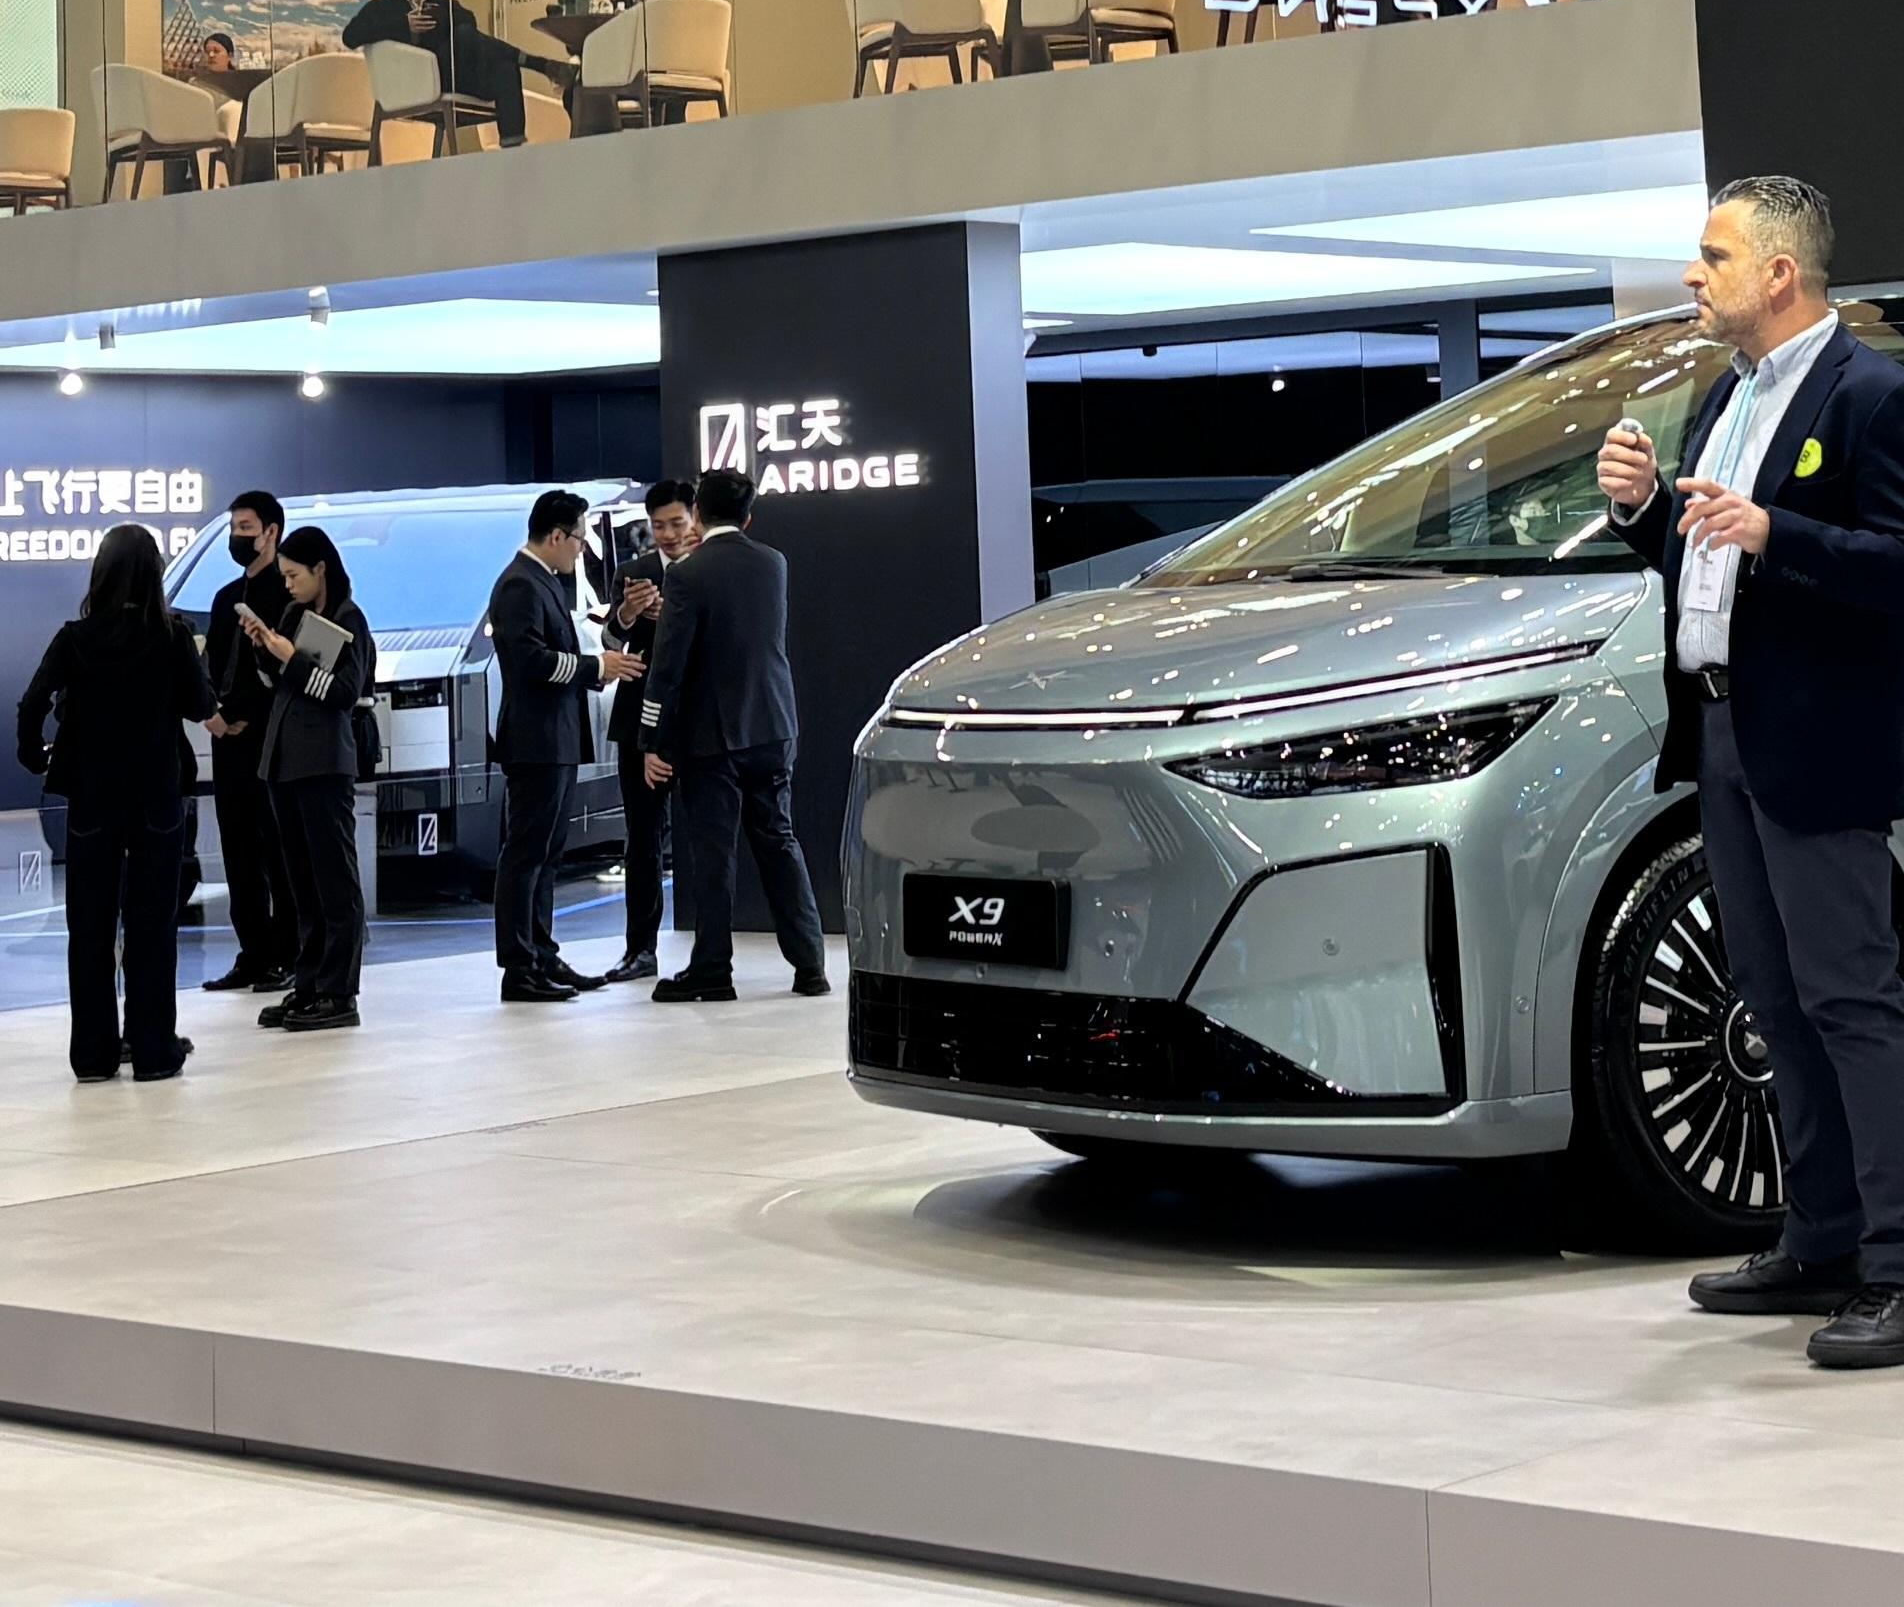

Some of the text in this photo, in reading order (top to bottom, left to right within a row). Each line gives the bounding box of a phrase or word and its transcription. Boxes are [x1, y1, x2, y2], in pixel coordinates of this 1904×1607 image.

[756, 398, 843, 452] 汇天
[758, 453, 920, 496] ARIDGE
[947, 896, 1005, 926] X9
